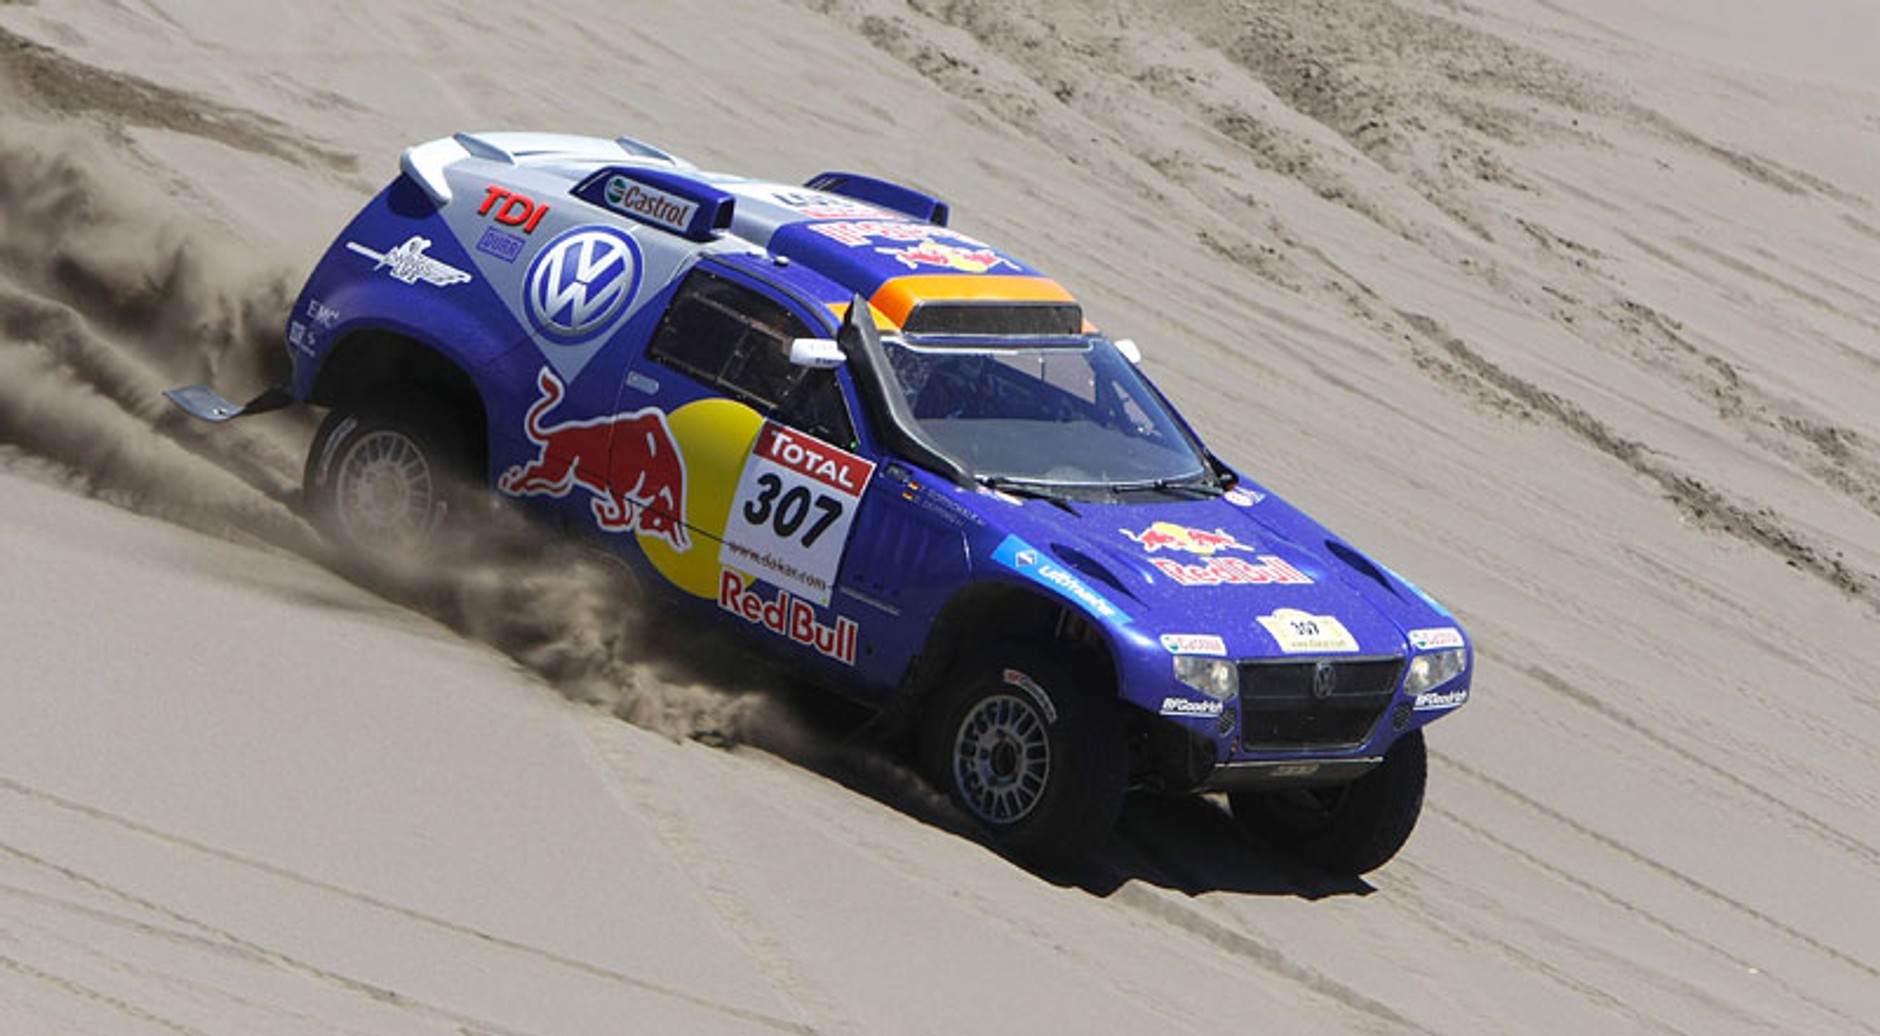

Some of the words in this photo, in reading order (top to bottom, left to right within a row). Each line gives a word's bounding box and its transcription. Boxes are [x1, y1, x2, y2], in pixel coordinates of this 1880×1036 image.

[477, 185, 549, 234] TDI
[624, 186, 689, 227] Castrol
[771, 432, 854, 488] TOTAL
[743, 473, 843, 548] 307
[719, 568, 789, 635] Red
[790, 598, 858, 667] Bull
